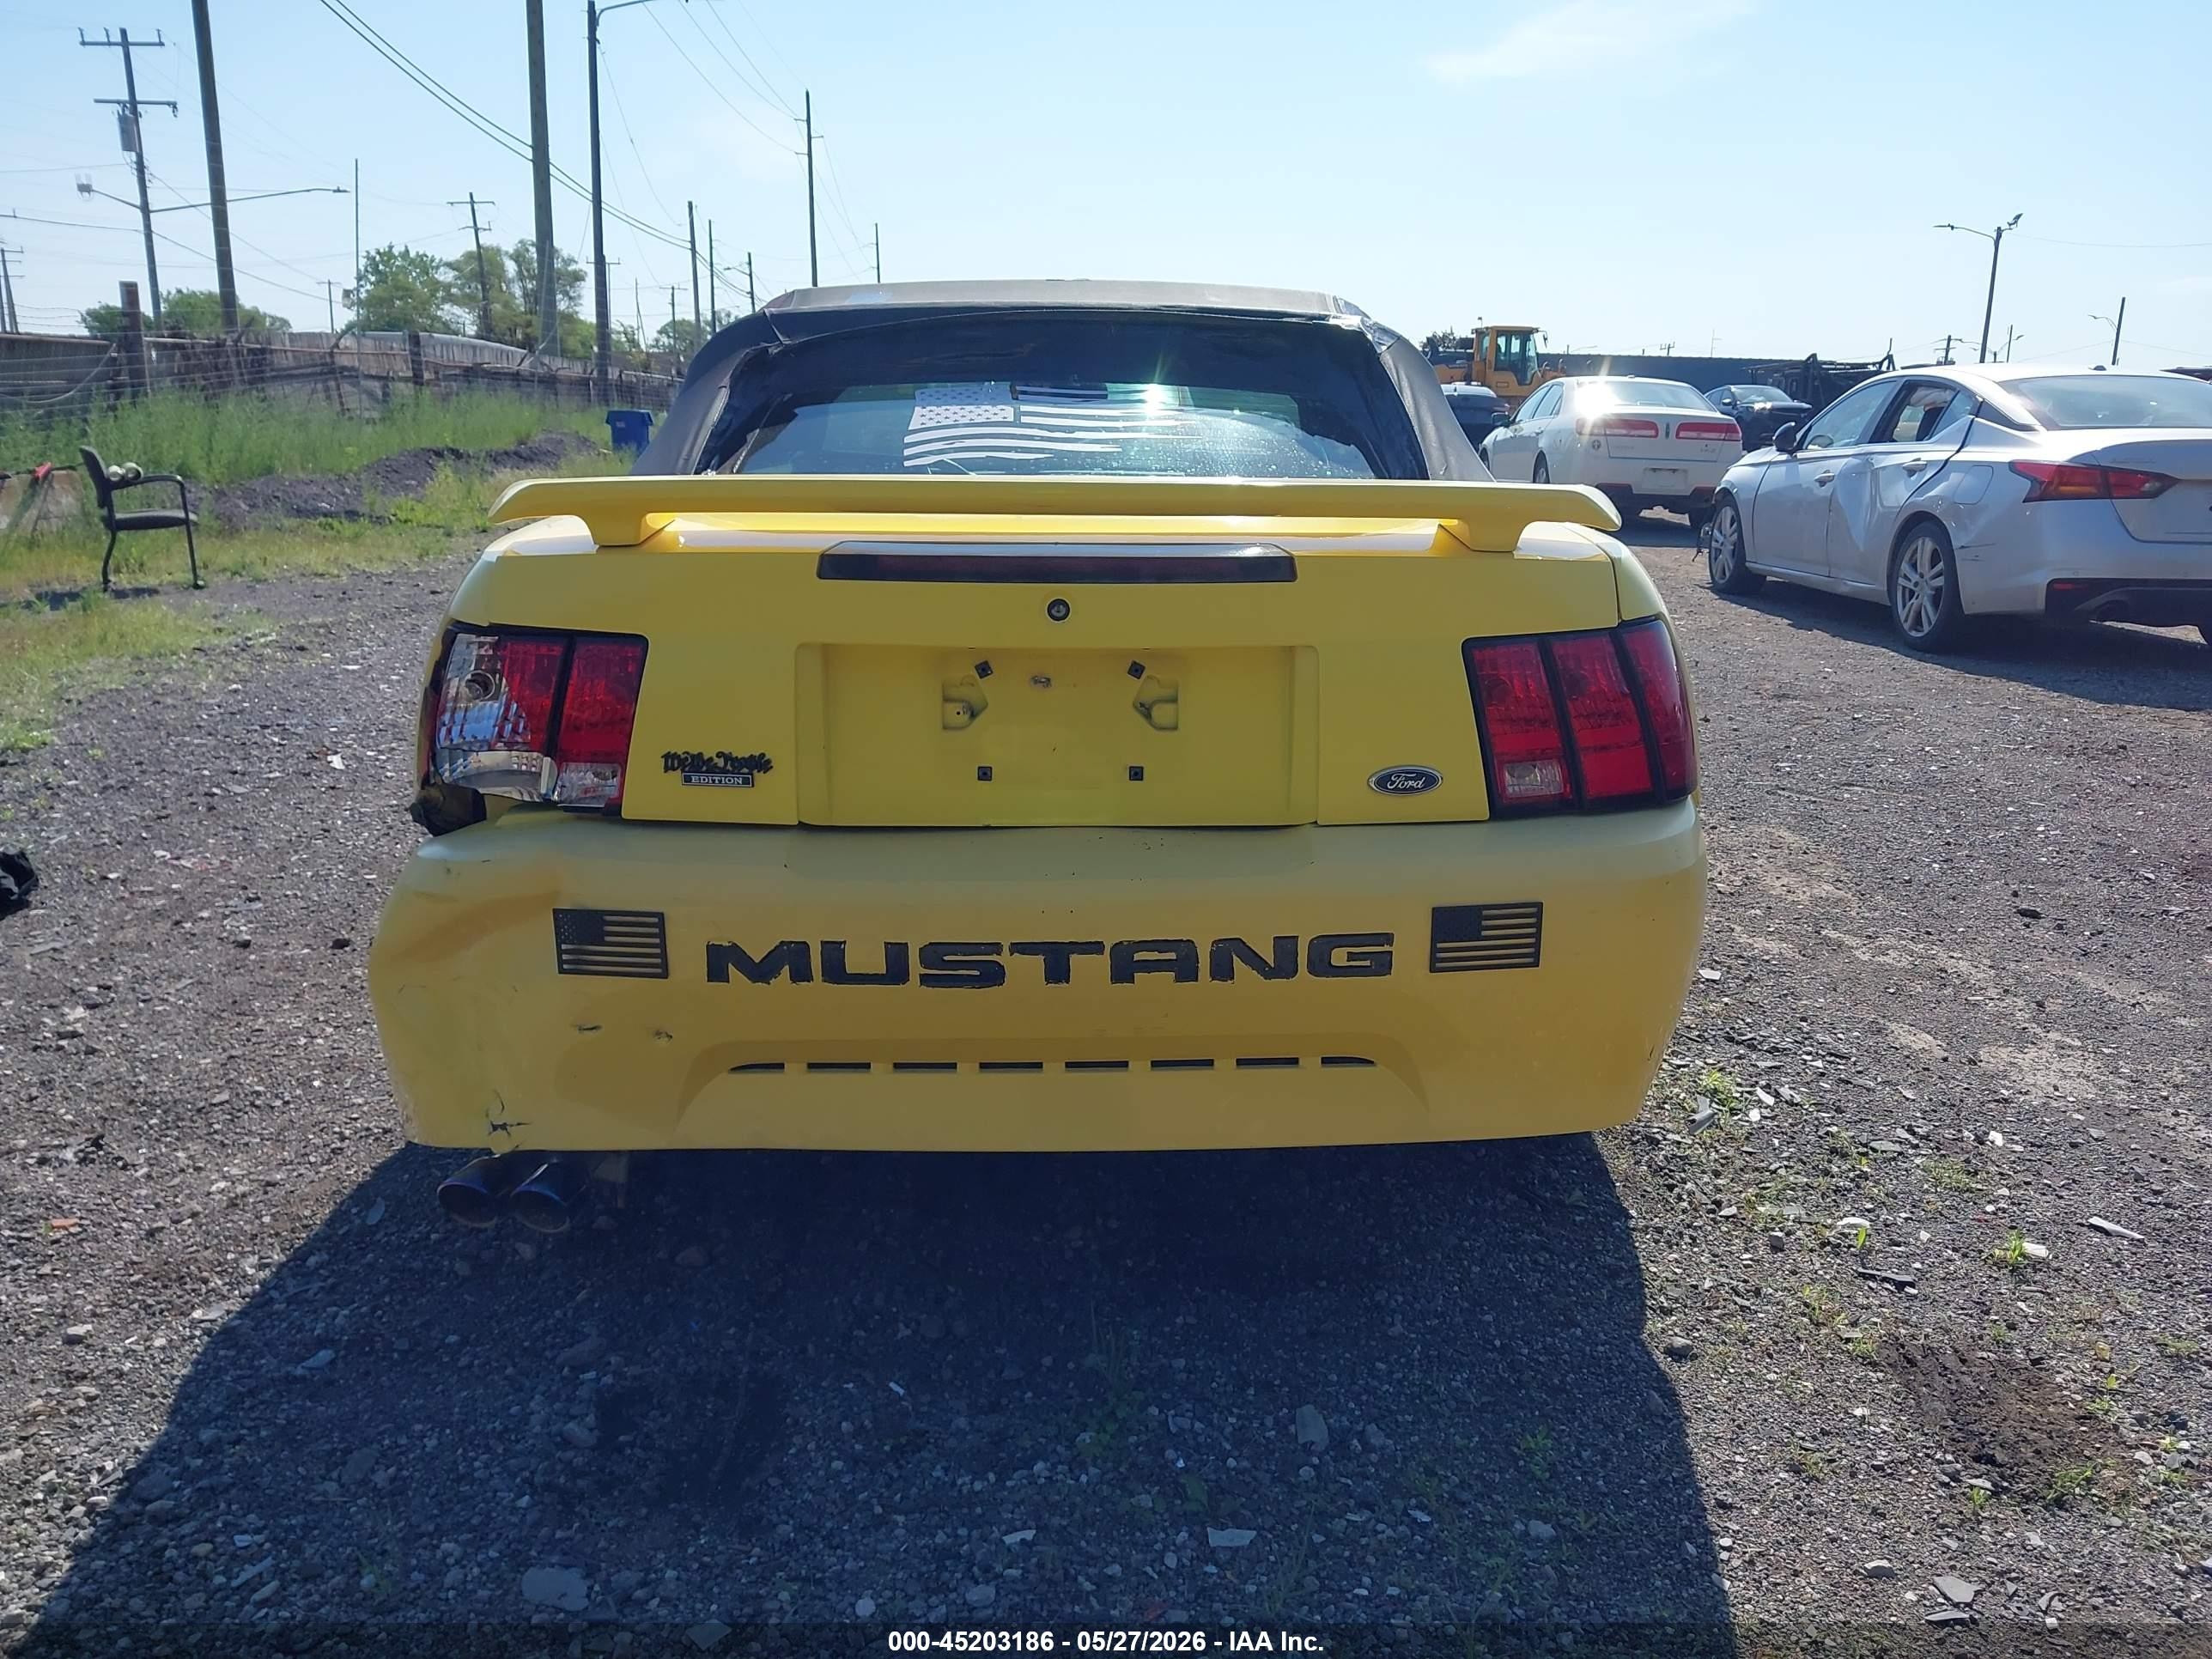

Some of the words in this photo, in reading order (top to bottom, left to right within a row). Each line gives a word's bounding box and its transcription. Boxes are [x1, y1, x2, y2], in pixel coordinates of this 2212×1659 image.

[690, 775, 743, 785] EDITION
[1387, 773, 1425, 789] Ford
[706, 932, 1395, 989] MUSTANG
